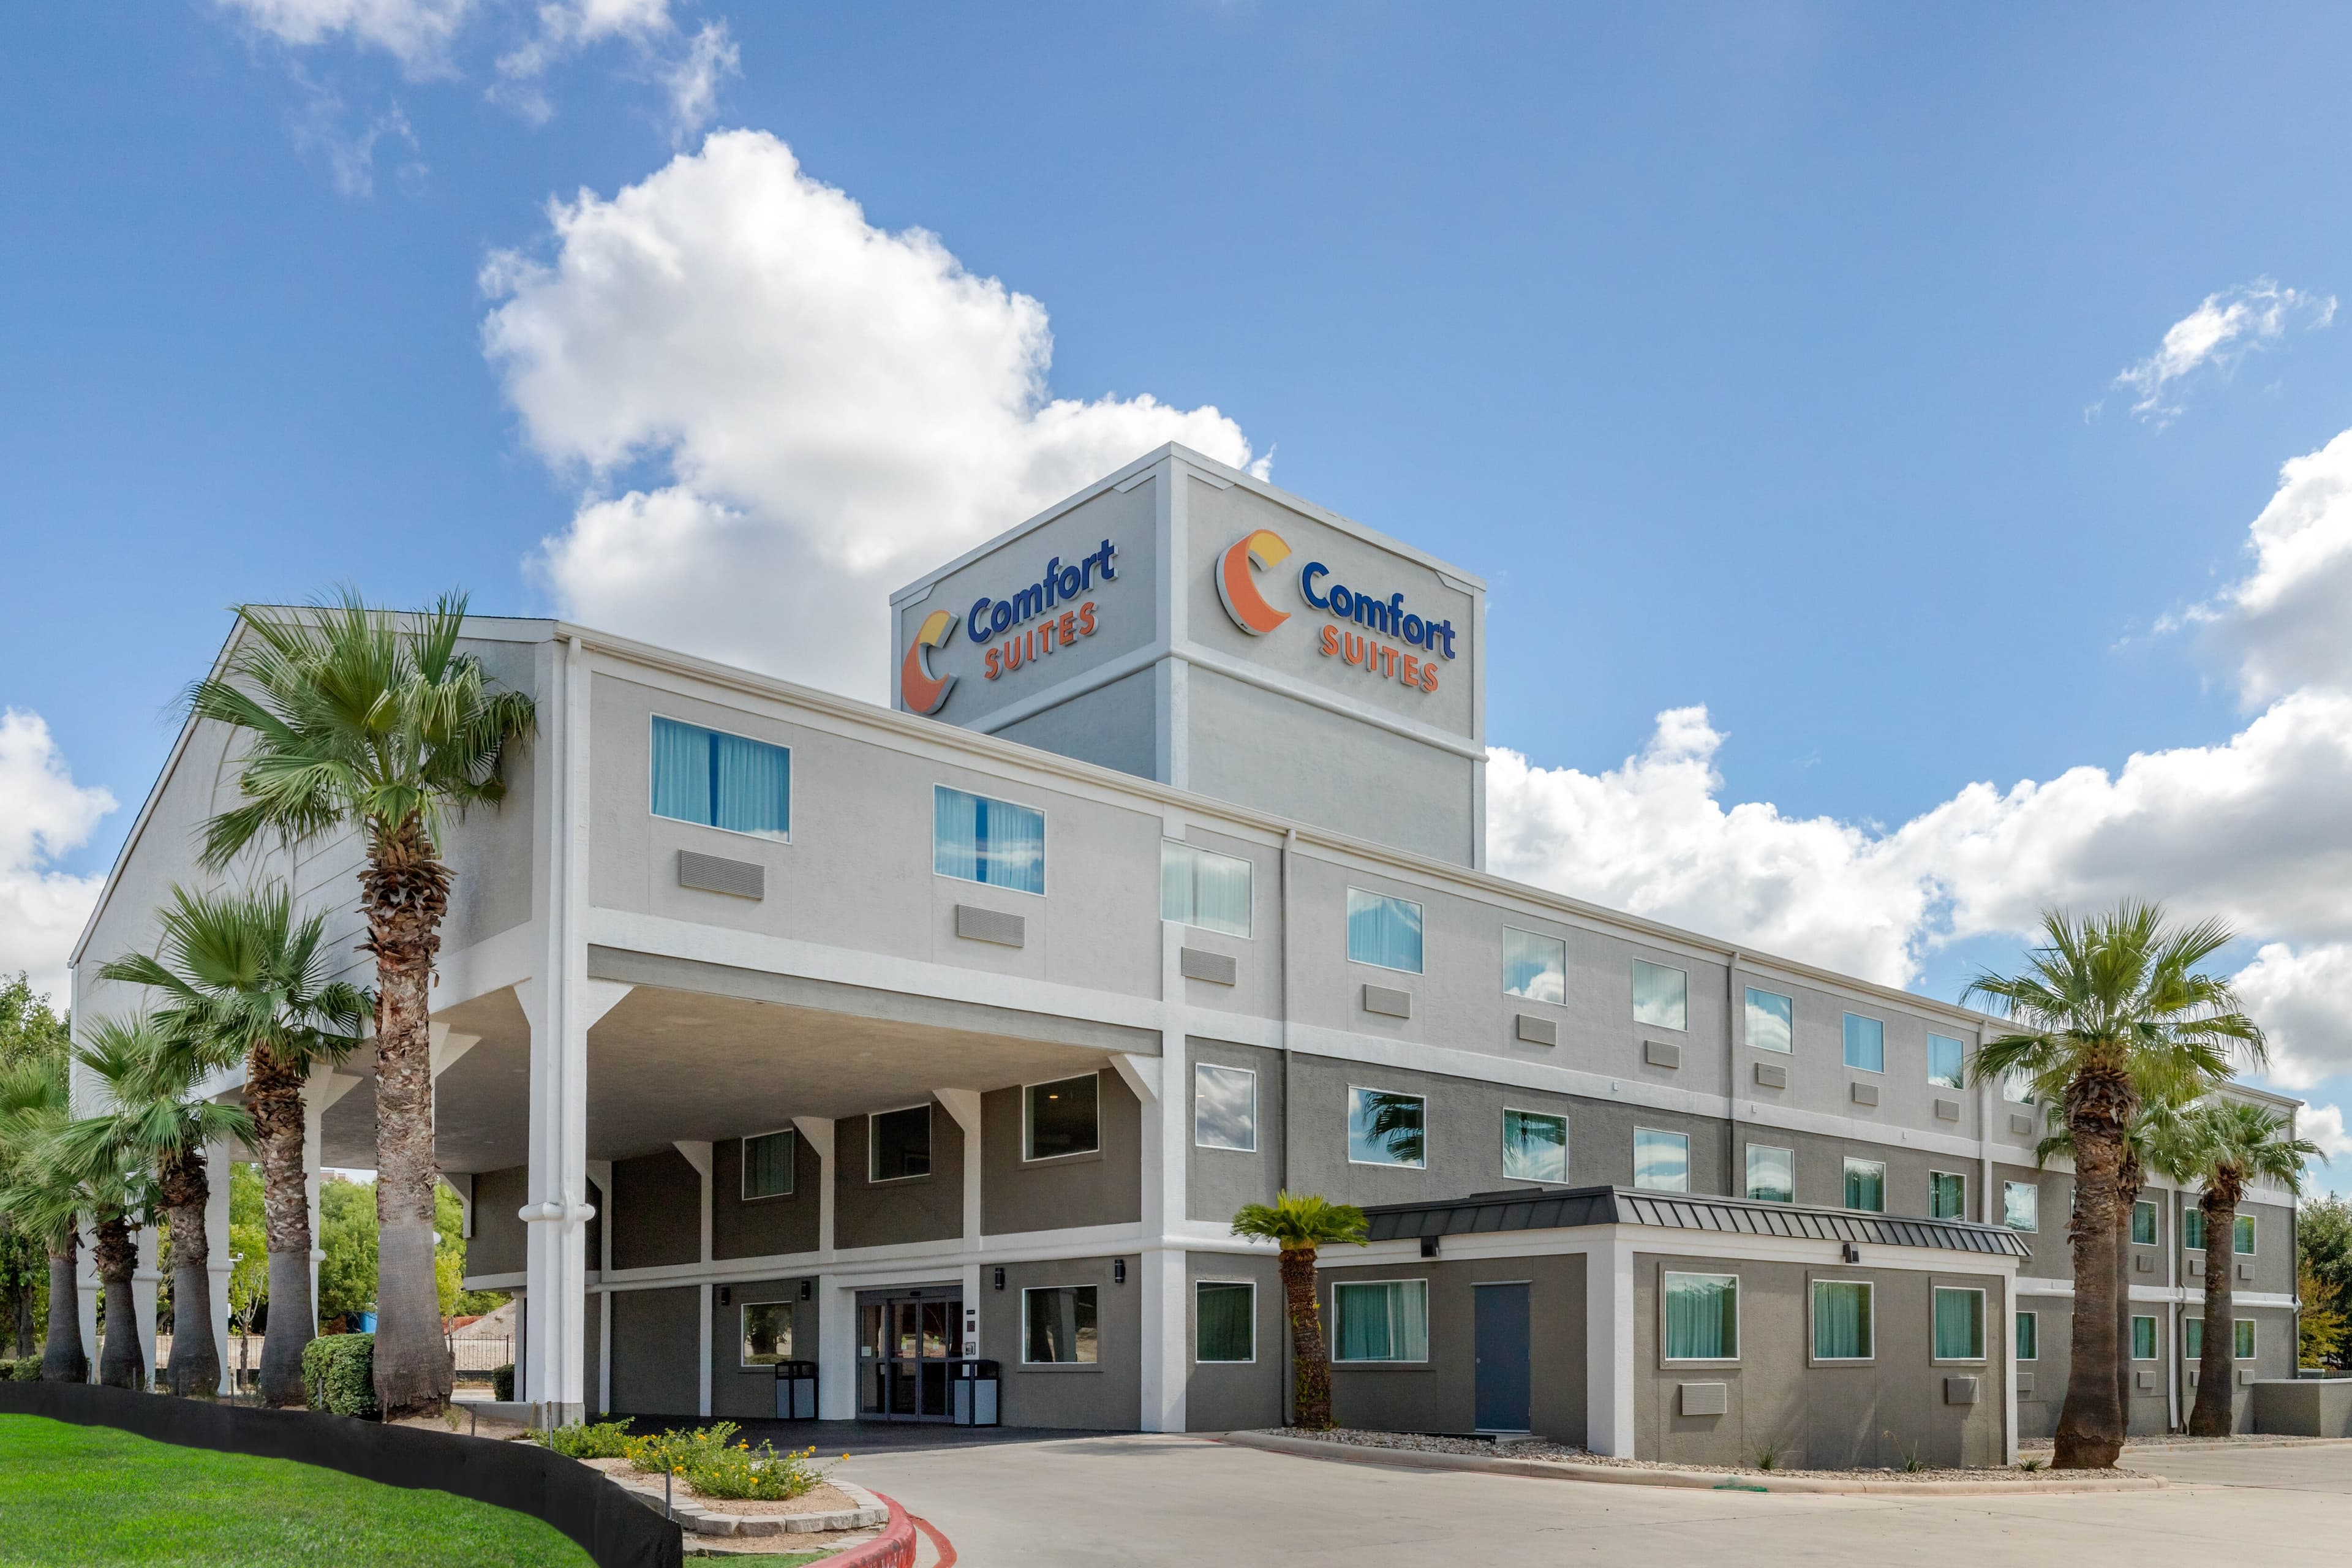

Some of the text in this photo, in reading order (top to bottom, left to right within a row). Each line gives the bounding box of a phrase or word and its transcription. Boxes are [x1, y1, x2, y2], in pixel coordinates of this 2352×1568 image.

[968, 538, 1117, 643] Comfort
[1300, 562, 1455, 660] Comfort
[984, 601, 1098, 680] SUITES
[1320, 624, 1438, 692] SUITES
